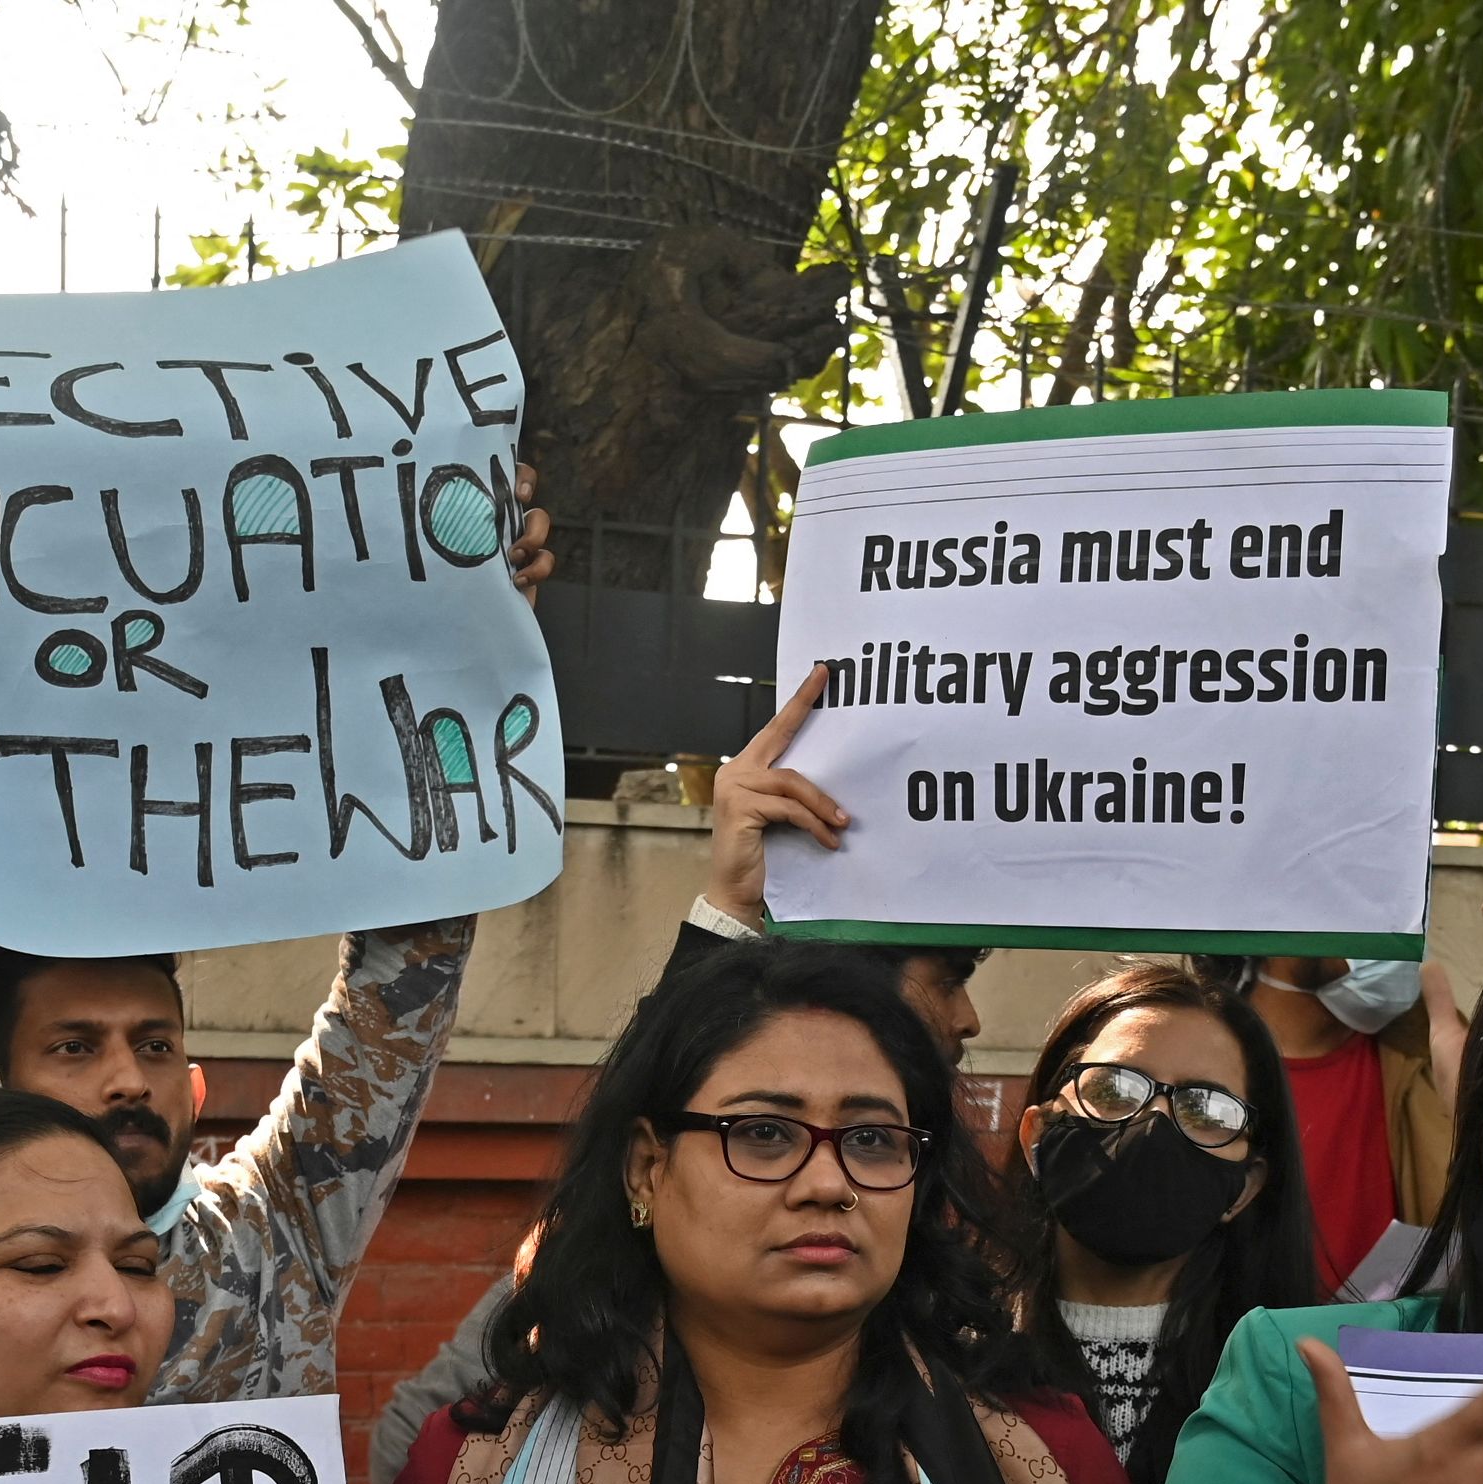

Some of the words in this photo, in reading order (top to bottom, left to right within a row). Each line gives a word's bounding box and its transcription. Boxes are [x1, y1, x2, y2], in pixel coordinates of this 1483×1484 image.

[860, 520, 1040, 592] Russia
[1059, 518, 1212, 583] must
[1229, 509, 1344, 580] end
[34, 608, 208, 699] OR
[812, 640, 1033, 717] military
[1048, 634, 1388, 717] aggression
[907, 770, 975, 822] on
[994, 757, 1247, 825] Ukraine!
